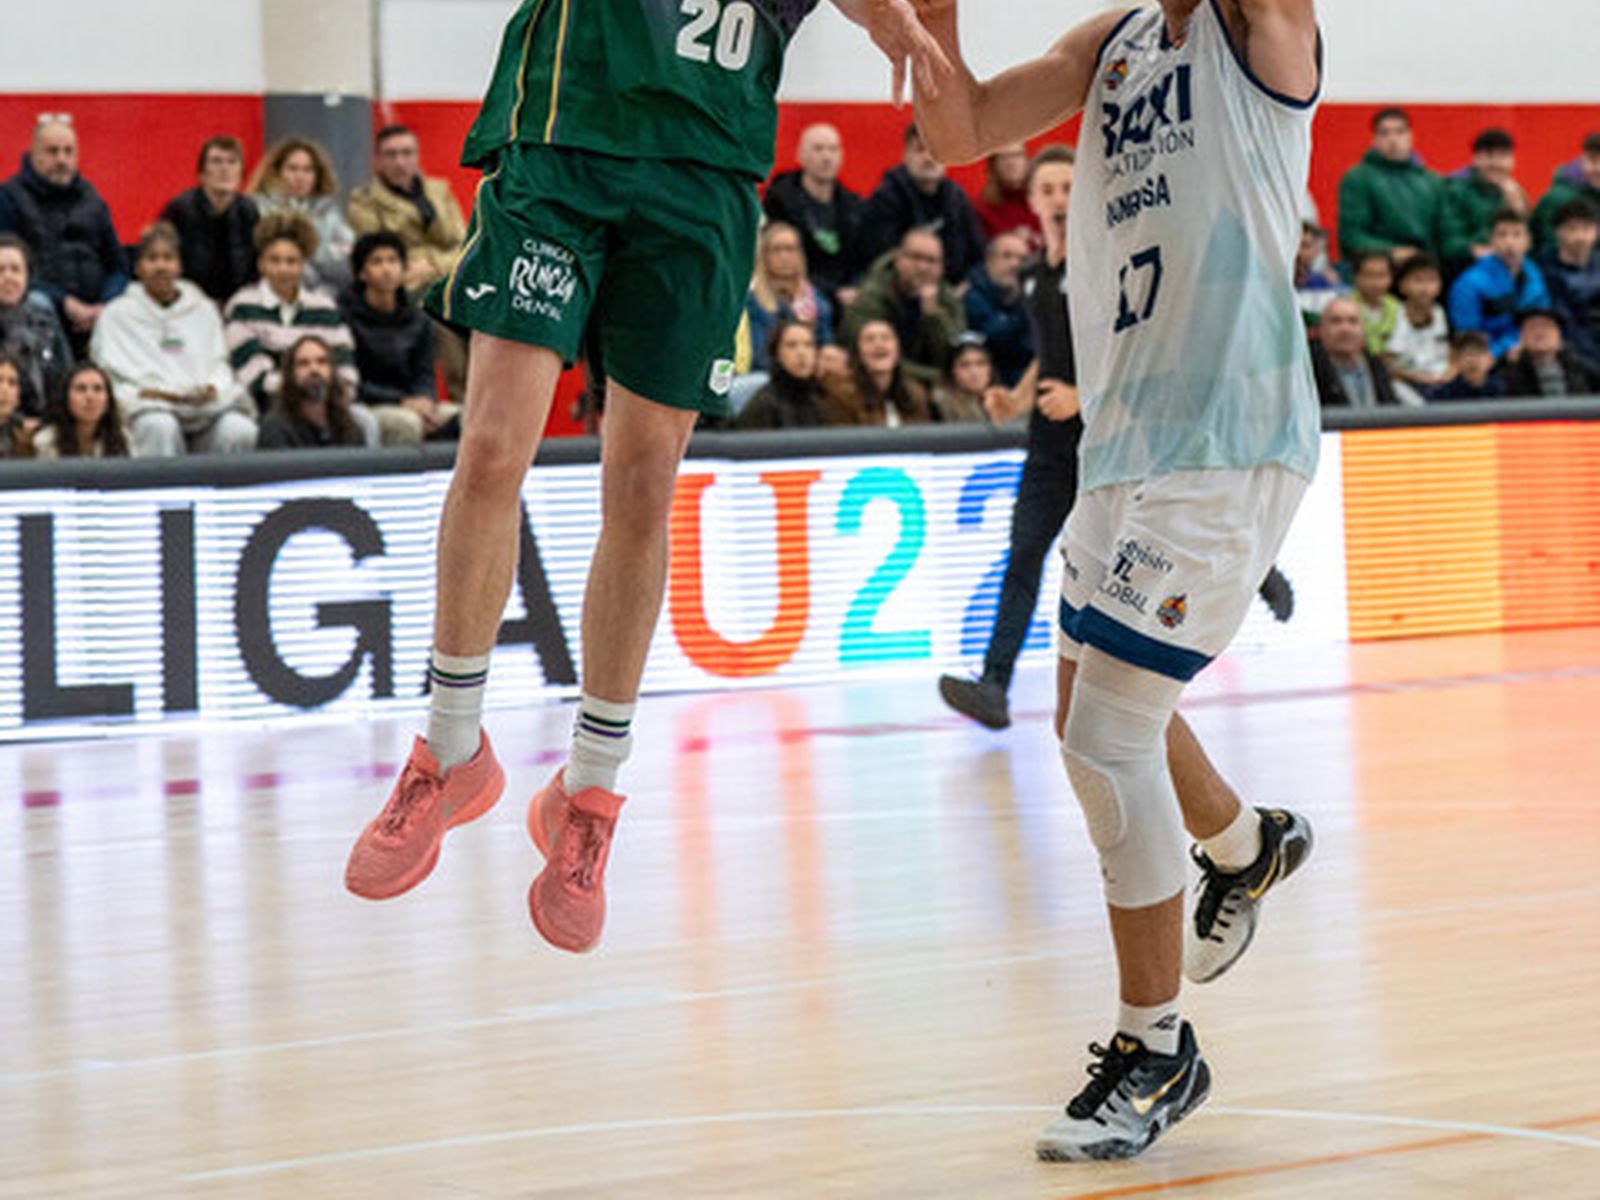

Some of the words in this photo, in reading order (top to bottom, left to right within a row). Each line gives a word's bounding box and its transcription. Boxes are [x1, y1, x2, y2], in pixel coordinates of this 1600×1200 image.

[1102, 63, 1193, 158] BAXI
[1113, 245, 1164, 333] 17
[18, 496, 578, 721] LIGA
[667, 461, 1051, 679] U22
